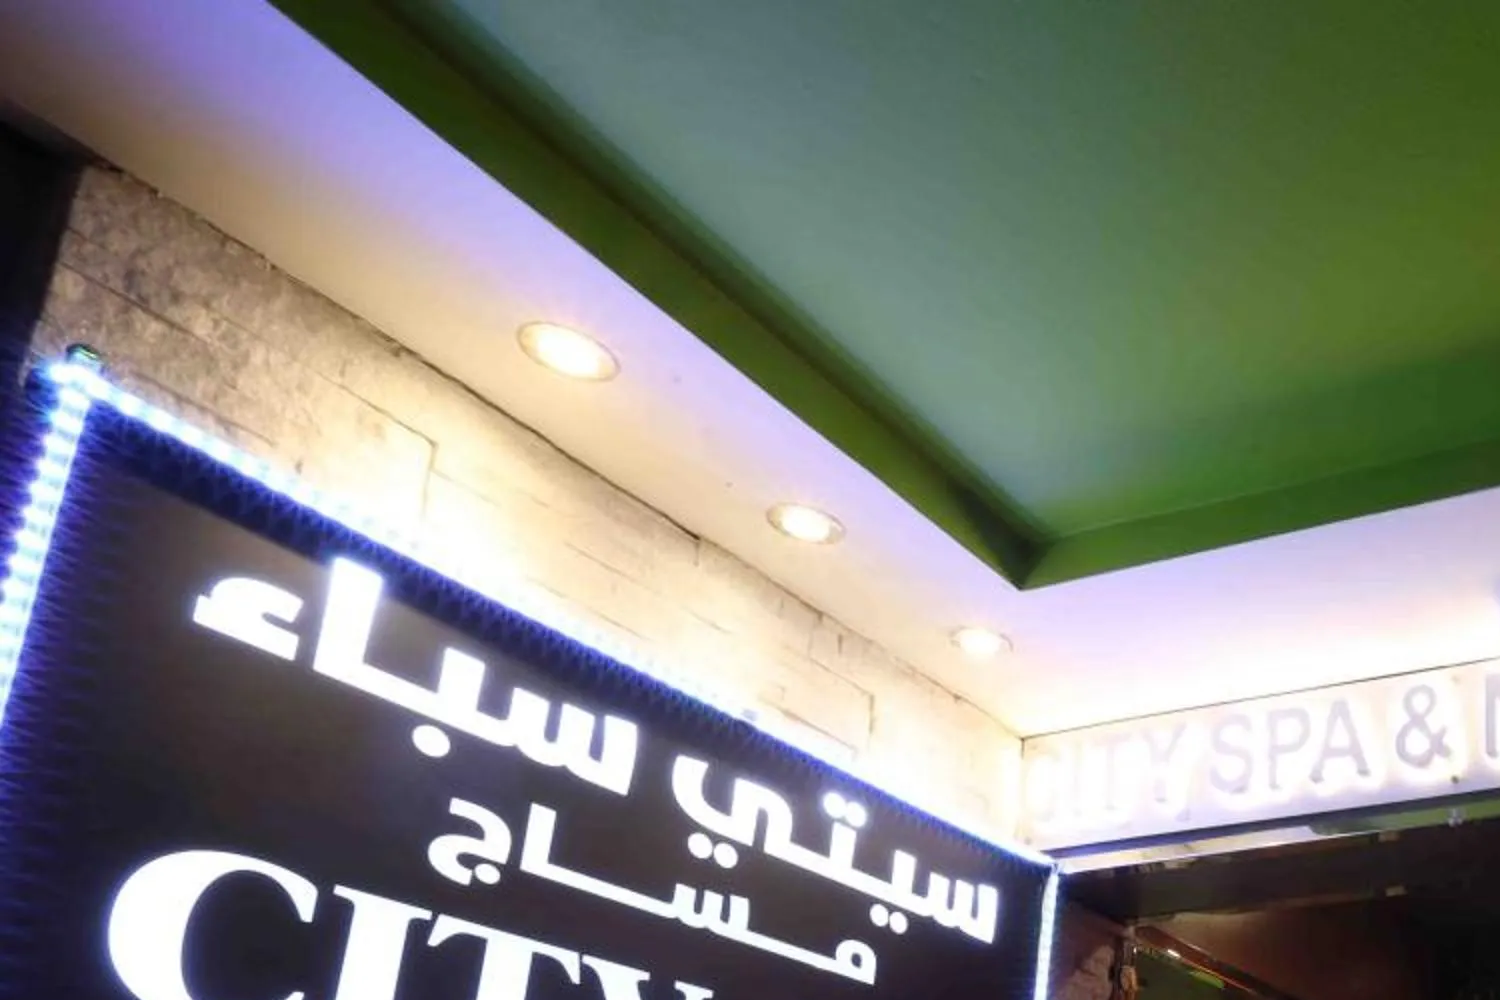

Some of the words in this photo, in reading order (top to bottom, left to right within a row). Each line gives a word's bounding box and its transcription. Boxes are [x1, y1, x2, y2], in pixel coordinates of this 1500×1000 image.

[193, 556, 638, 797] سباء
[1208, 698, 1371, 795] SPA
[1394, 683, 1453, 770] &
[427, 797, 877, 985] مساج
[671, 755, 999, 944] سيتي
